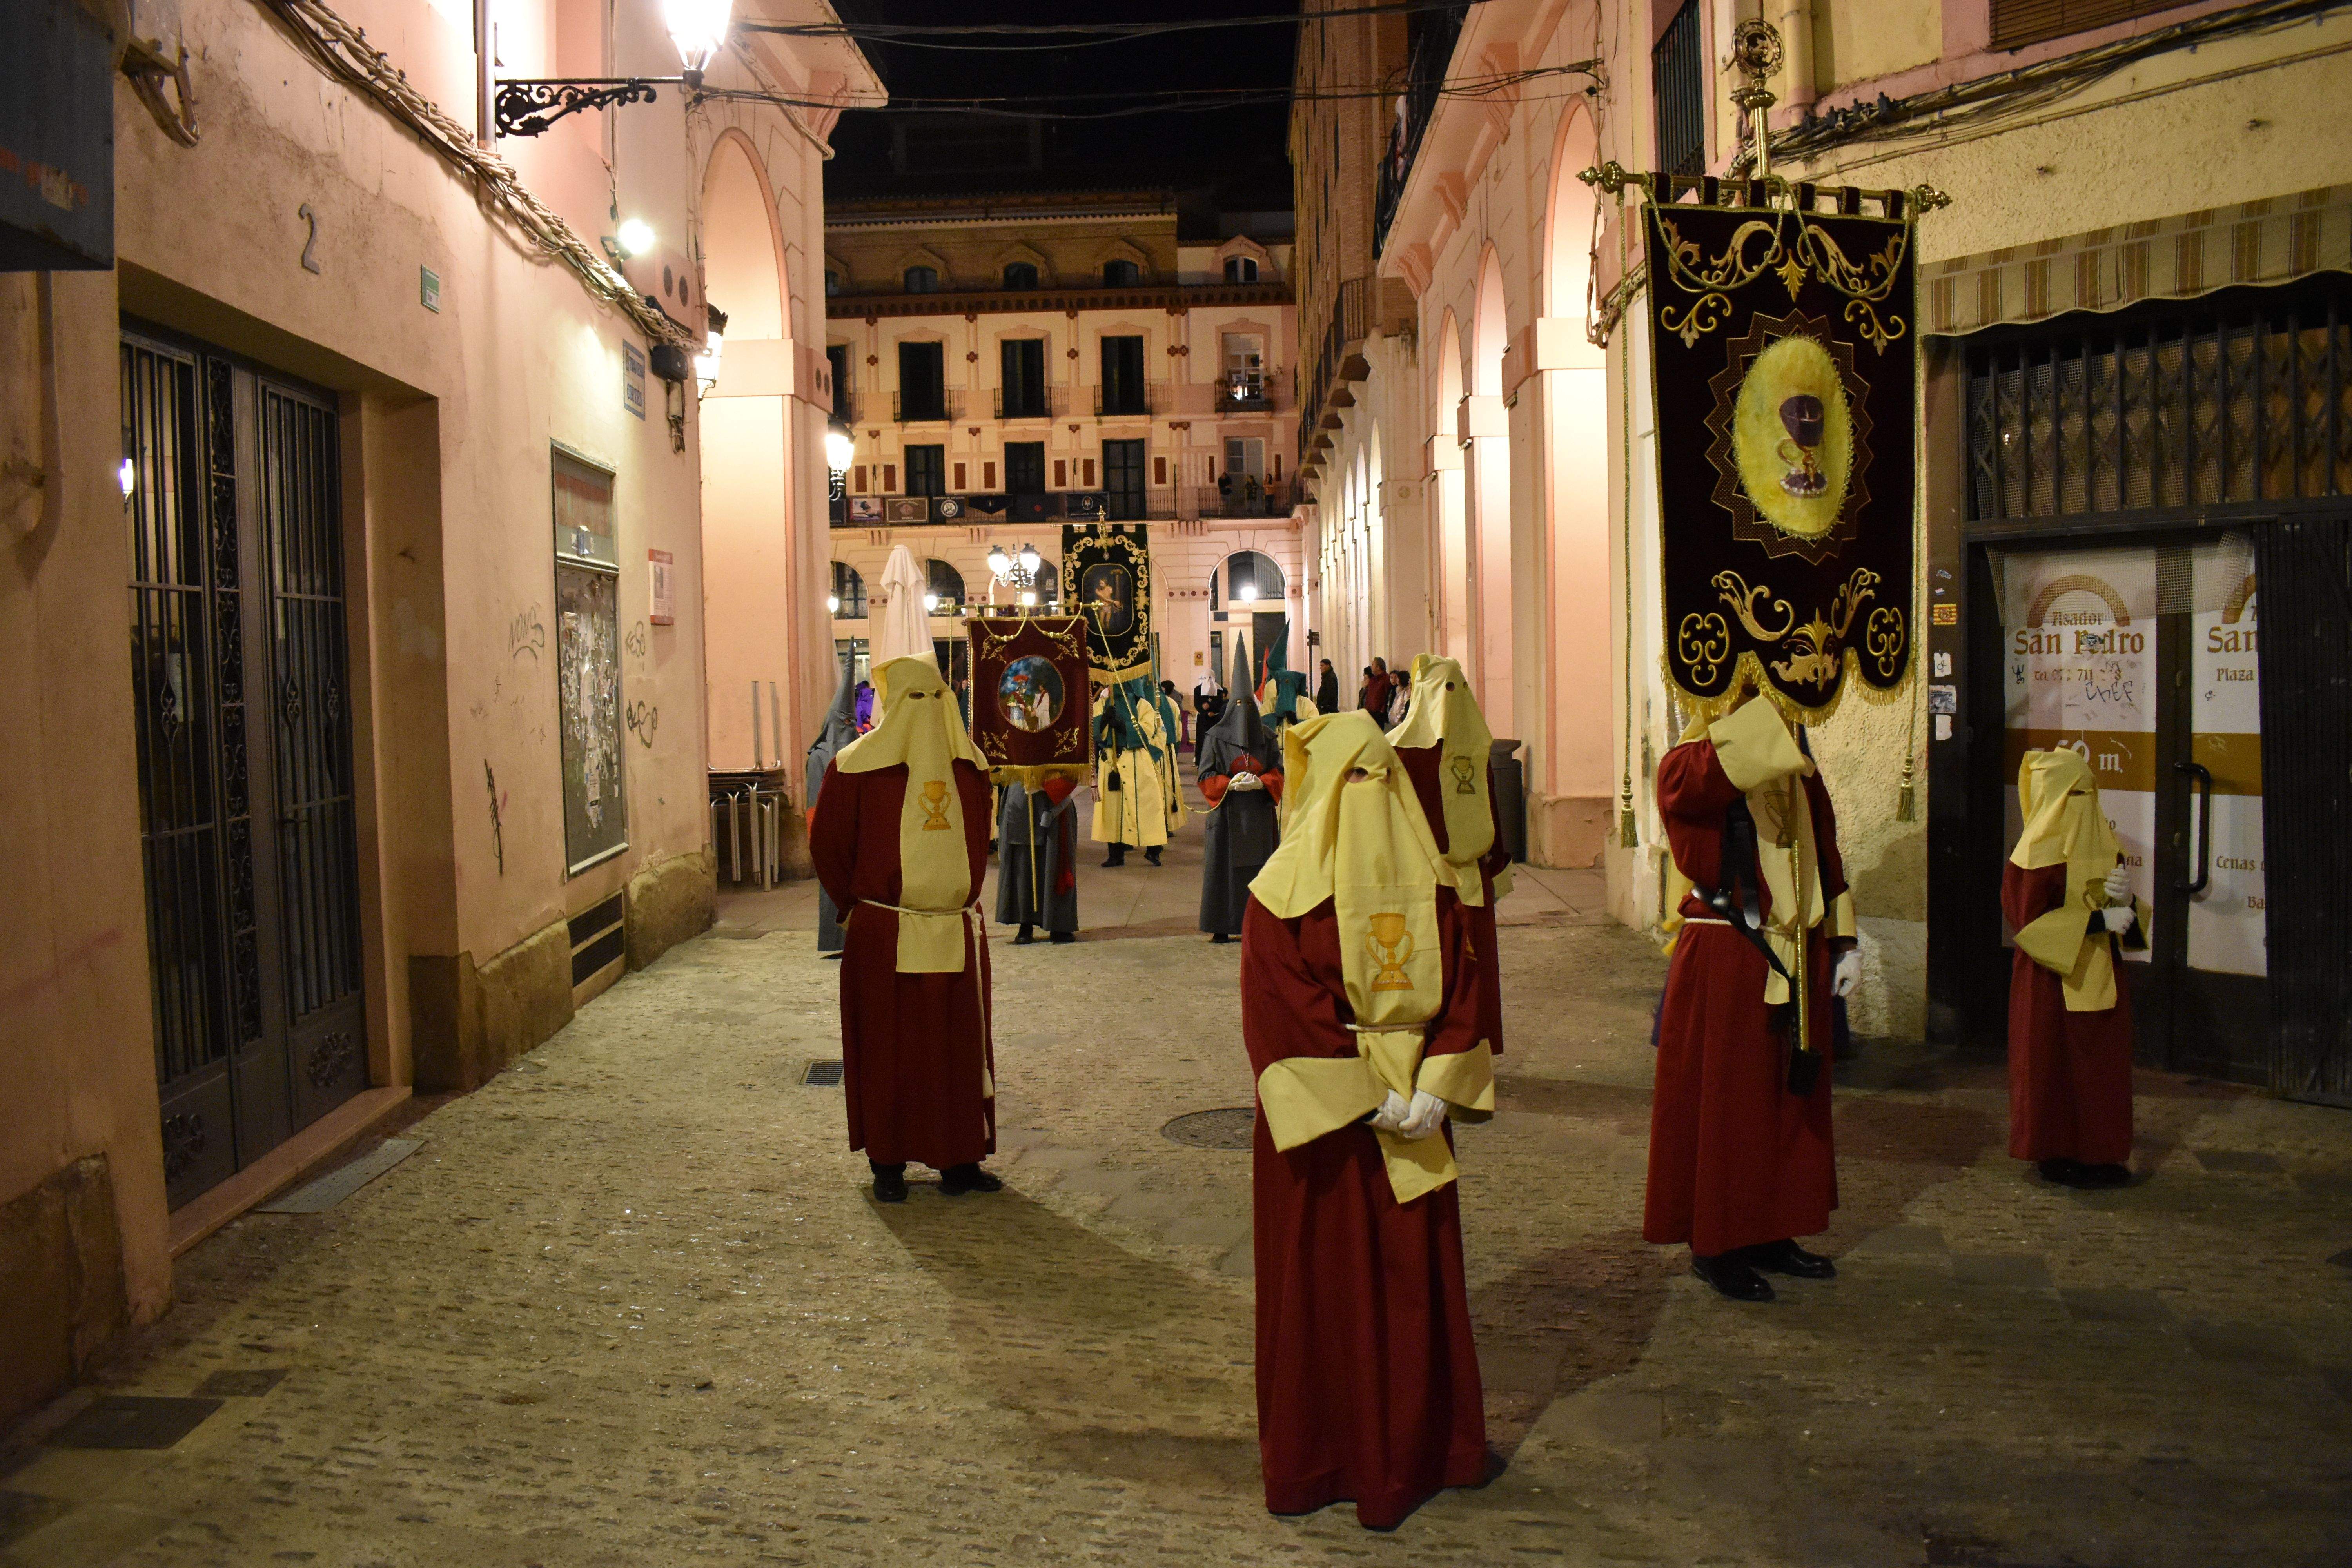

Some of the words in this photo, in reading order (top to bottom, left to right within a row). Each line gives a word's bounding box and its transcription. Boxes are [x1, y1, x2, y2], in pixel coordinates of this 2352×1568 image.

[298, 203, 320, 275] 2
[2052, 611, 2103, 626] Asador
[2014, 630, 2062, 655] San
[2216, 668, 2254, 681] Plaza
[2216, 855, 2255, 871] Cenas
